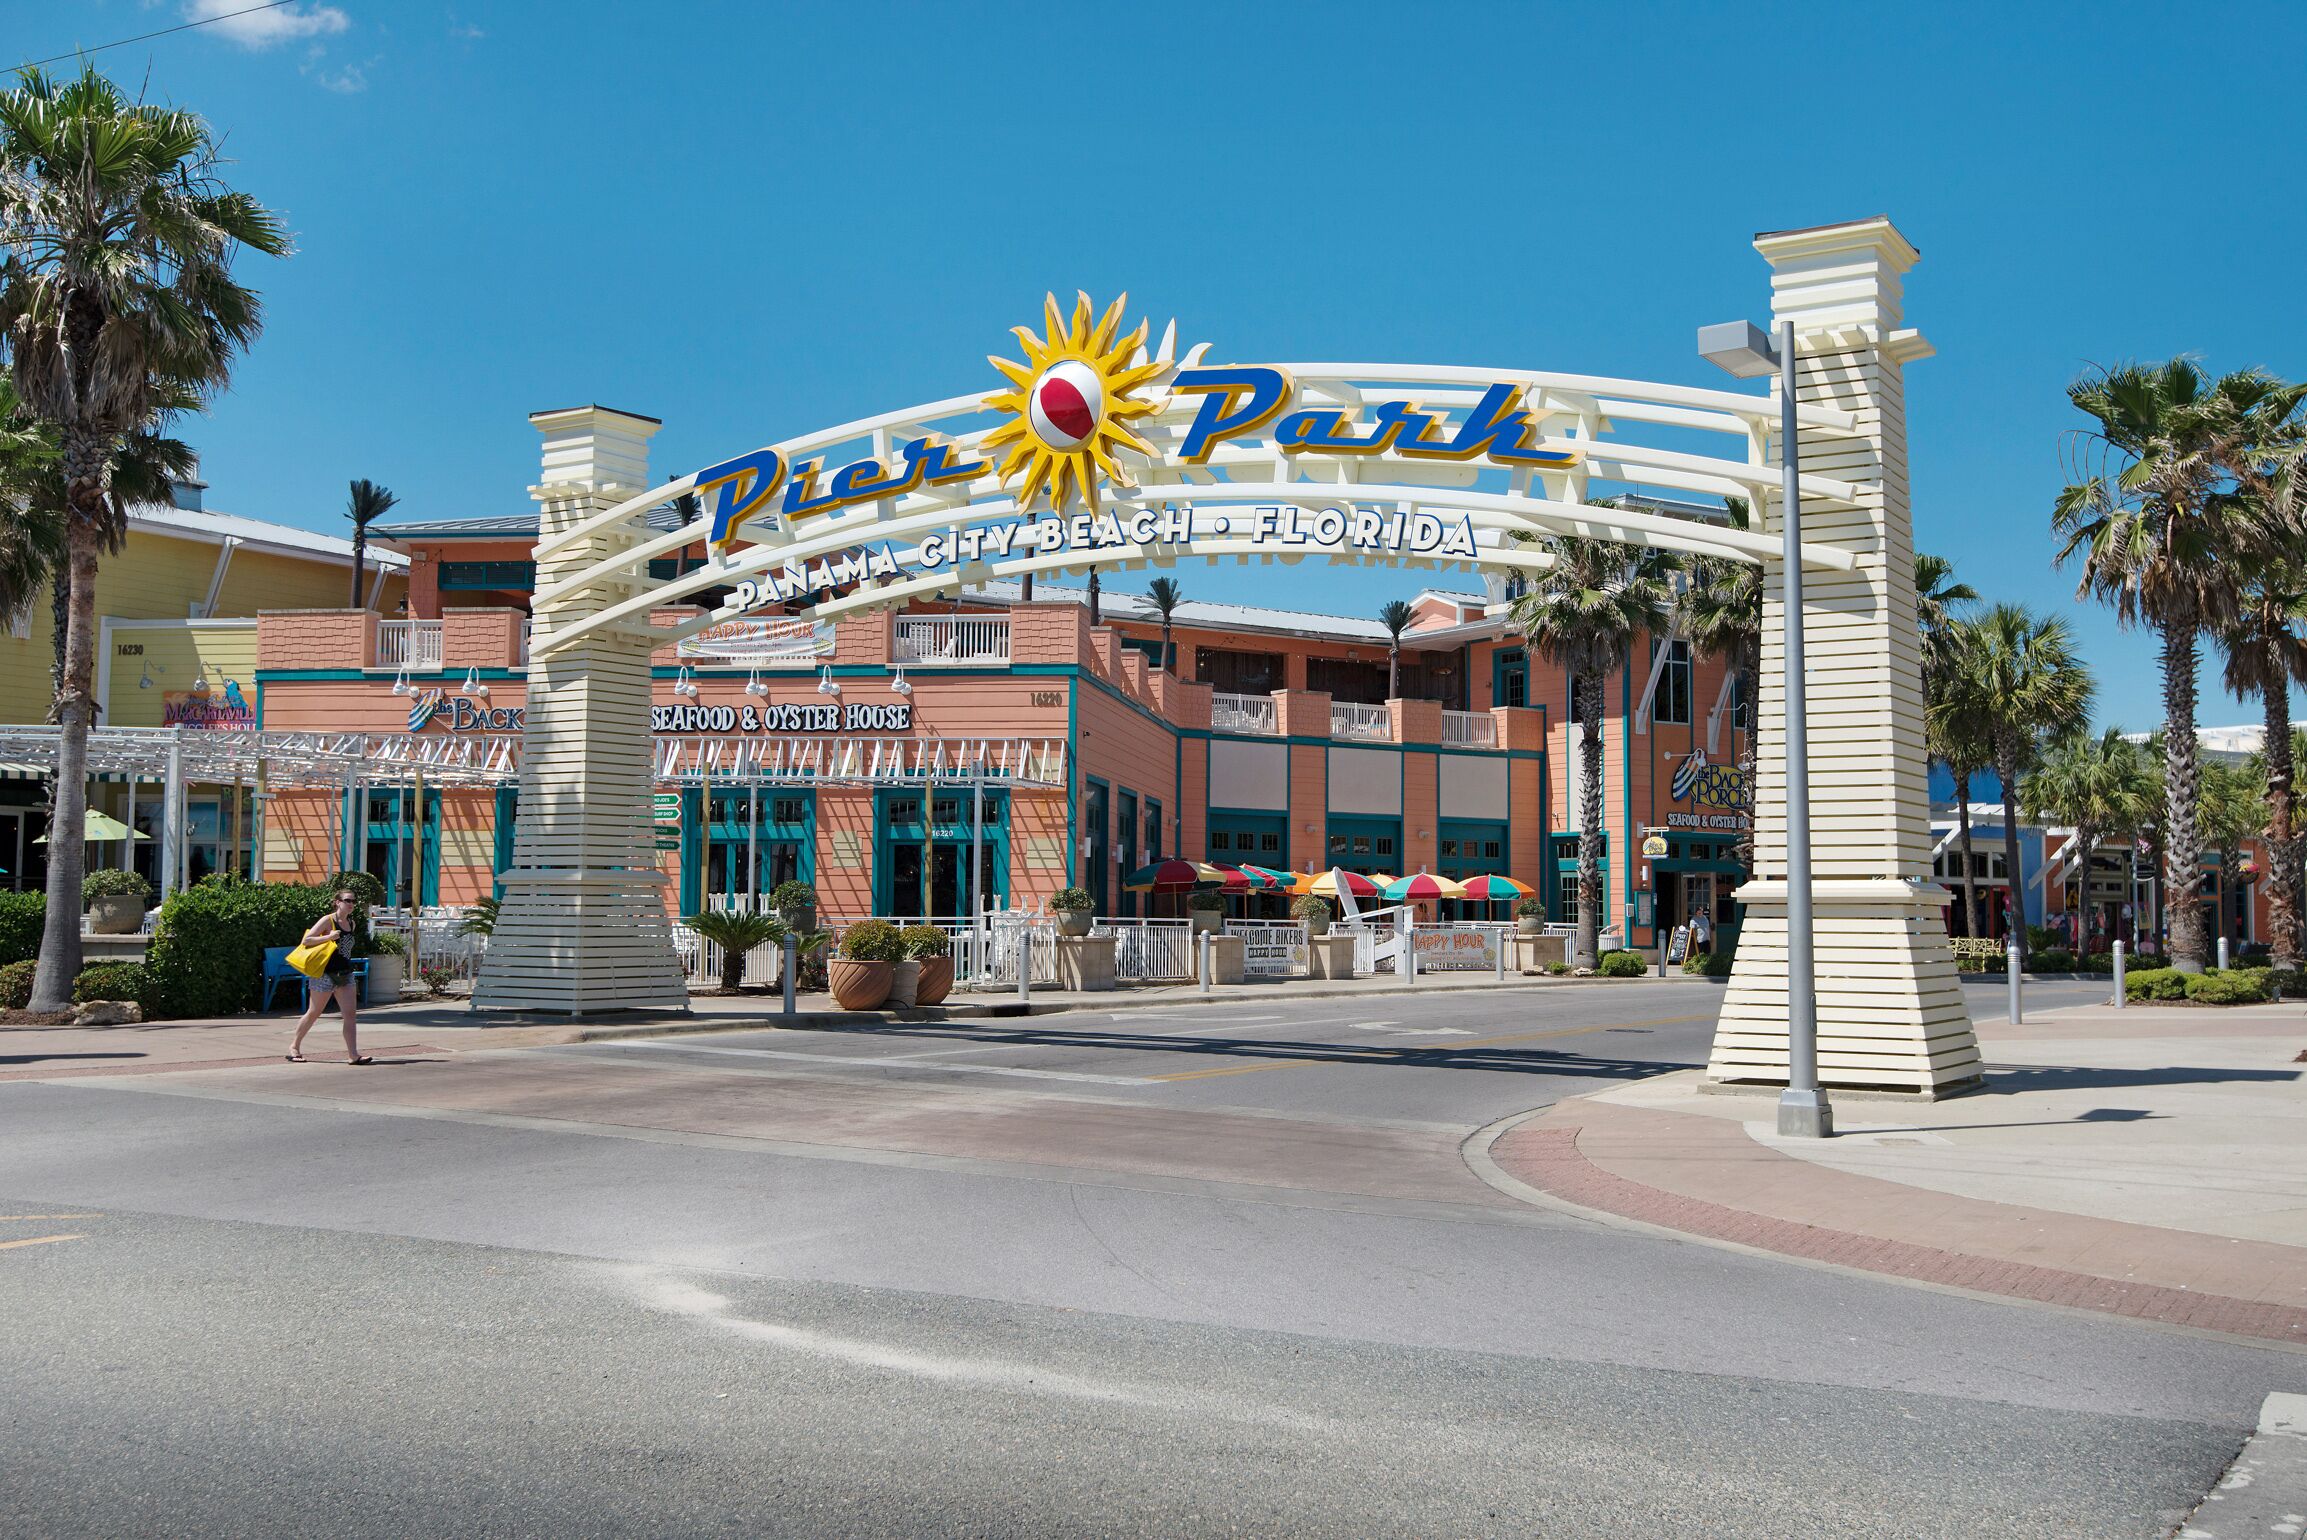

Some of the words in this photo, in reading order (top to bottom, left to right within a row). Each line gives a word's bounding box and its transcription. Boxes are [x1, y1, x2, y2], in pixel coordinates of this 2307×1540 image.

[693, 434, 993, 551] Pier
[1170, 364, 1590, 468] Park
[736, 540, 900, 612] PANAMA
[918, 521, 1021, 568] CITY
[1040, 507, 1193, 552] BEACH
[1251, 506, 1478, 558] FLORIDA
[698, 621, 760, 642] HAPPY
[765, 620, 815, 639] HOUR
[117, 644, 144, 656] 16230
[1031, 692, 1062, 707] 16220
[433, 698, 453, 714] the
[453, 697, 525, 731] BACK
[651, 704, 736, 731] SEAFOOD
[741, 704, 761, 731] &
[764, 703, 841, 731] OYSTER
[844, 703, 910, 731] HOUSE
[1696, 767, 1710, 779] the
[1667, 813, 1700, 827] SEAFOOD
[1701, 815, 1708, 827] &
[1710, 816, 1737, 829] OYSTER
[1275, 929, 1303, 945] BIKERS
[1453, 932, 1485, 950] HOUR
[1249, 948, 1269, 957] HAPPY
[1271, 947, 1287, 957] HOUR
